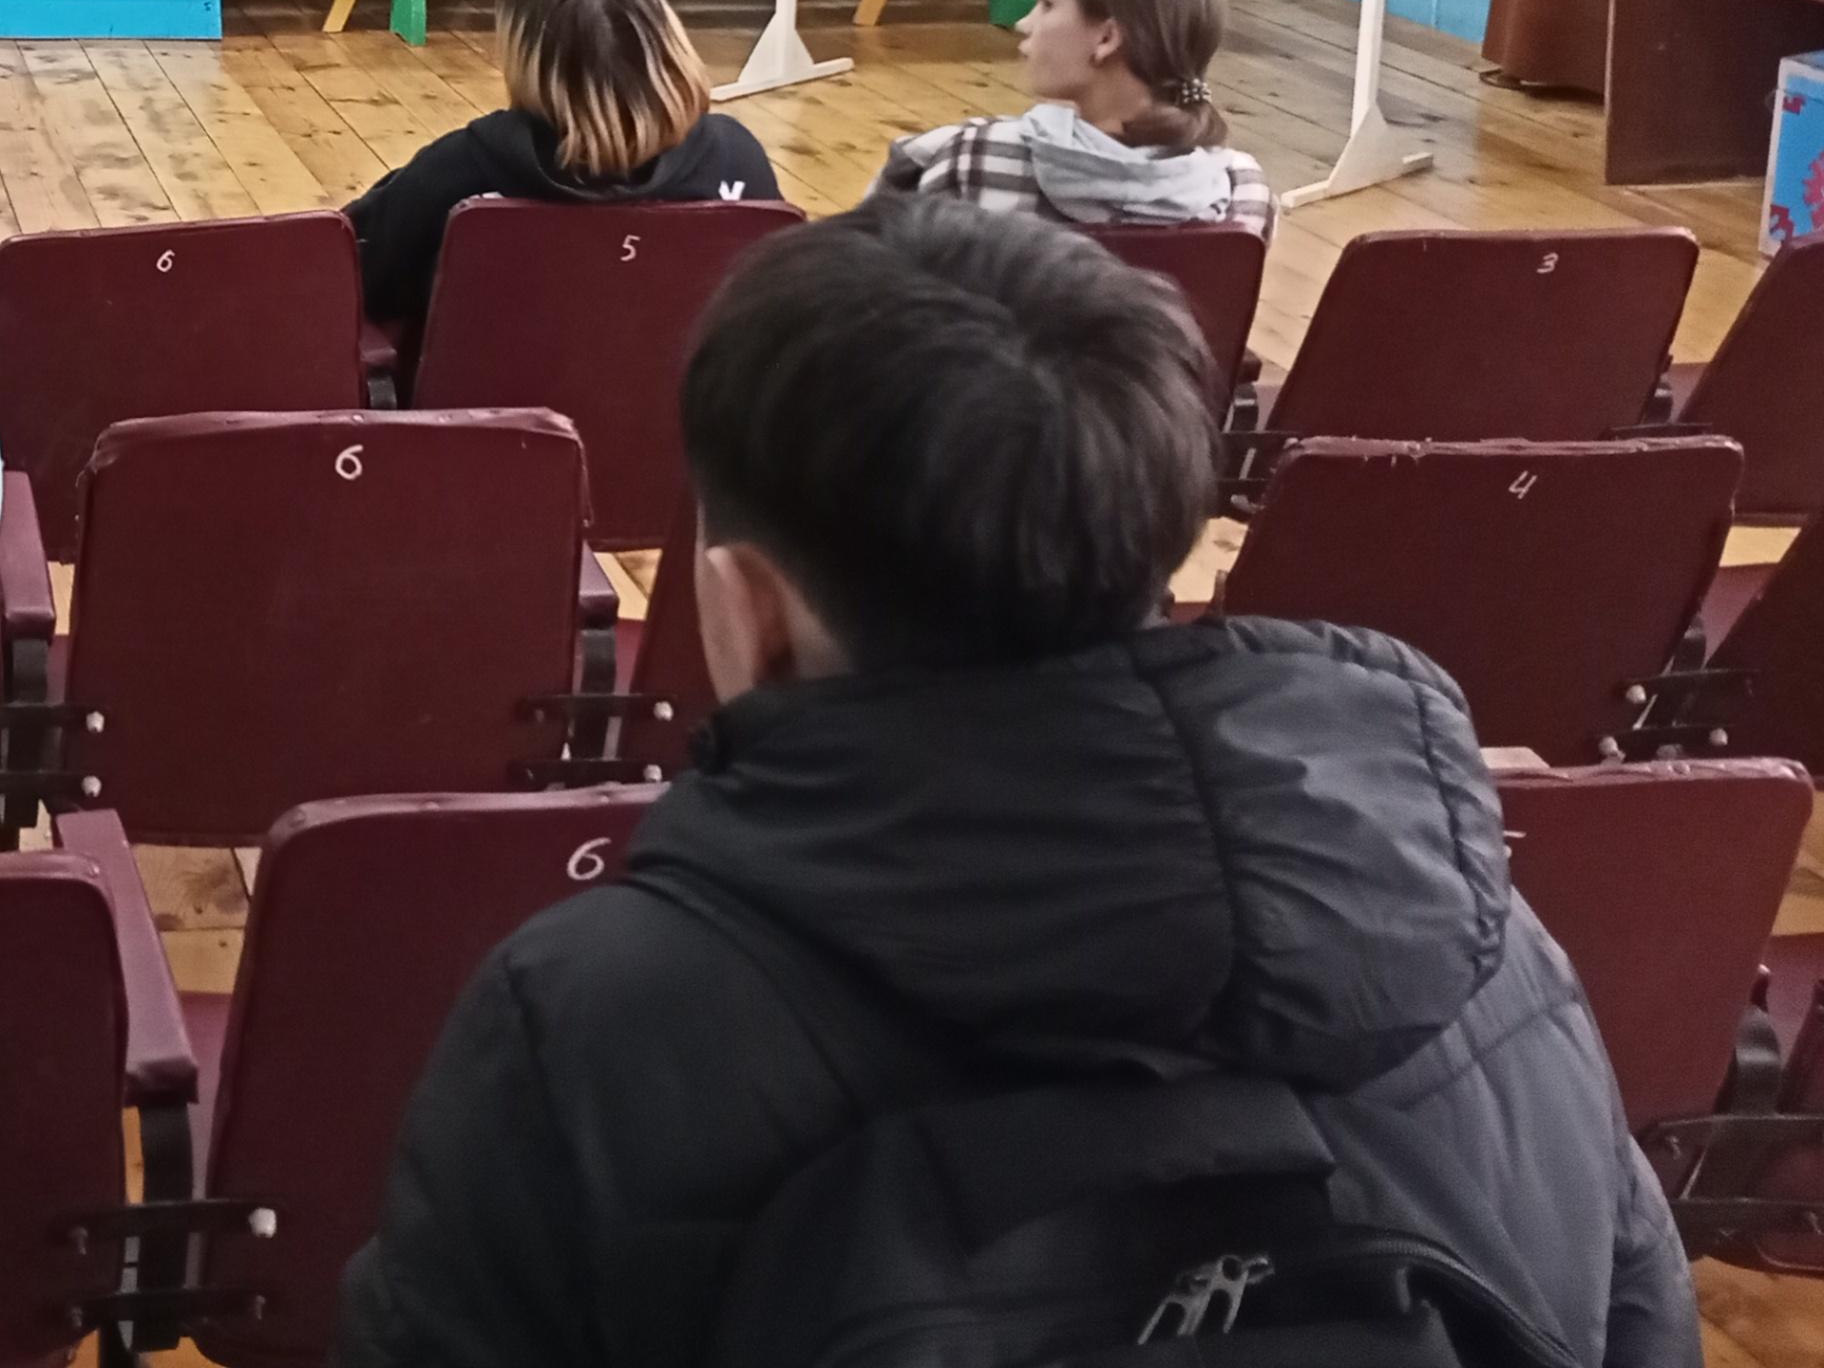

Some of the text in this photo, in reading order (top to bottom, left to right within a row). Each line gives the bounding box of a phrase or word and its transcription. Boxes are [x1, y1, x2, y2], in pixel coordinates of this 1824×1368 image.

[156, 249, 175, 274] 6
[621, 234, 641, 263] 5
[1536, 252, 1560, 275] 3
[333, 443, 365, 482] 6
[1507, 469, 1539, 501] 4
[565, 836, 613, 882] 6
